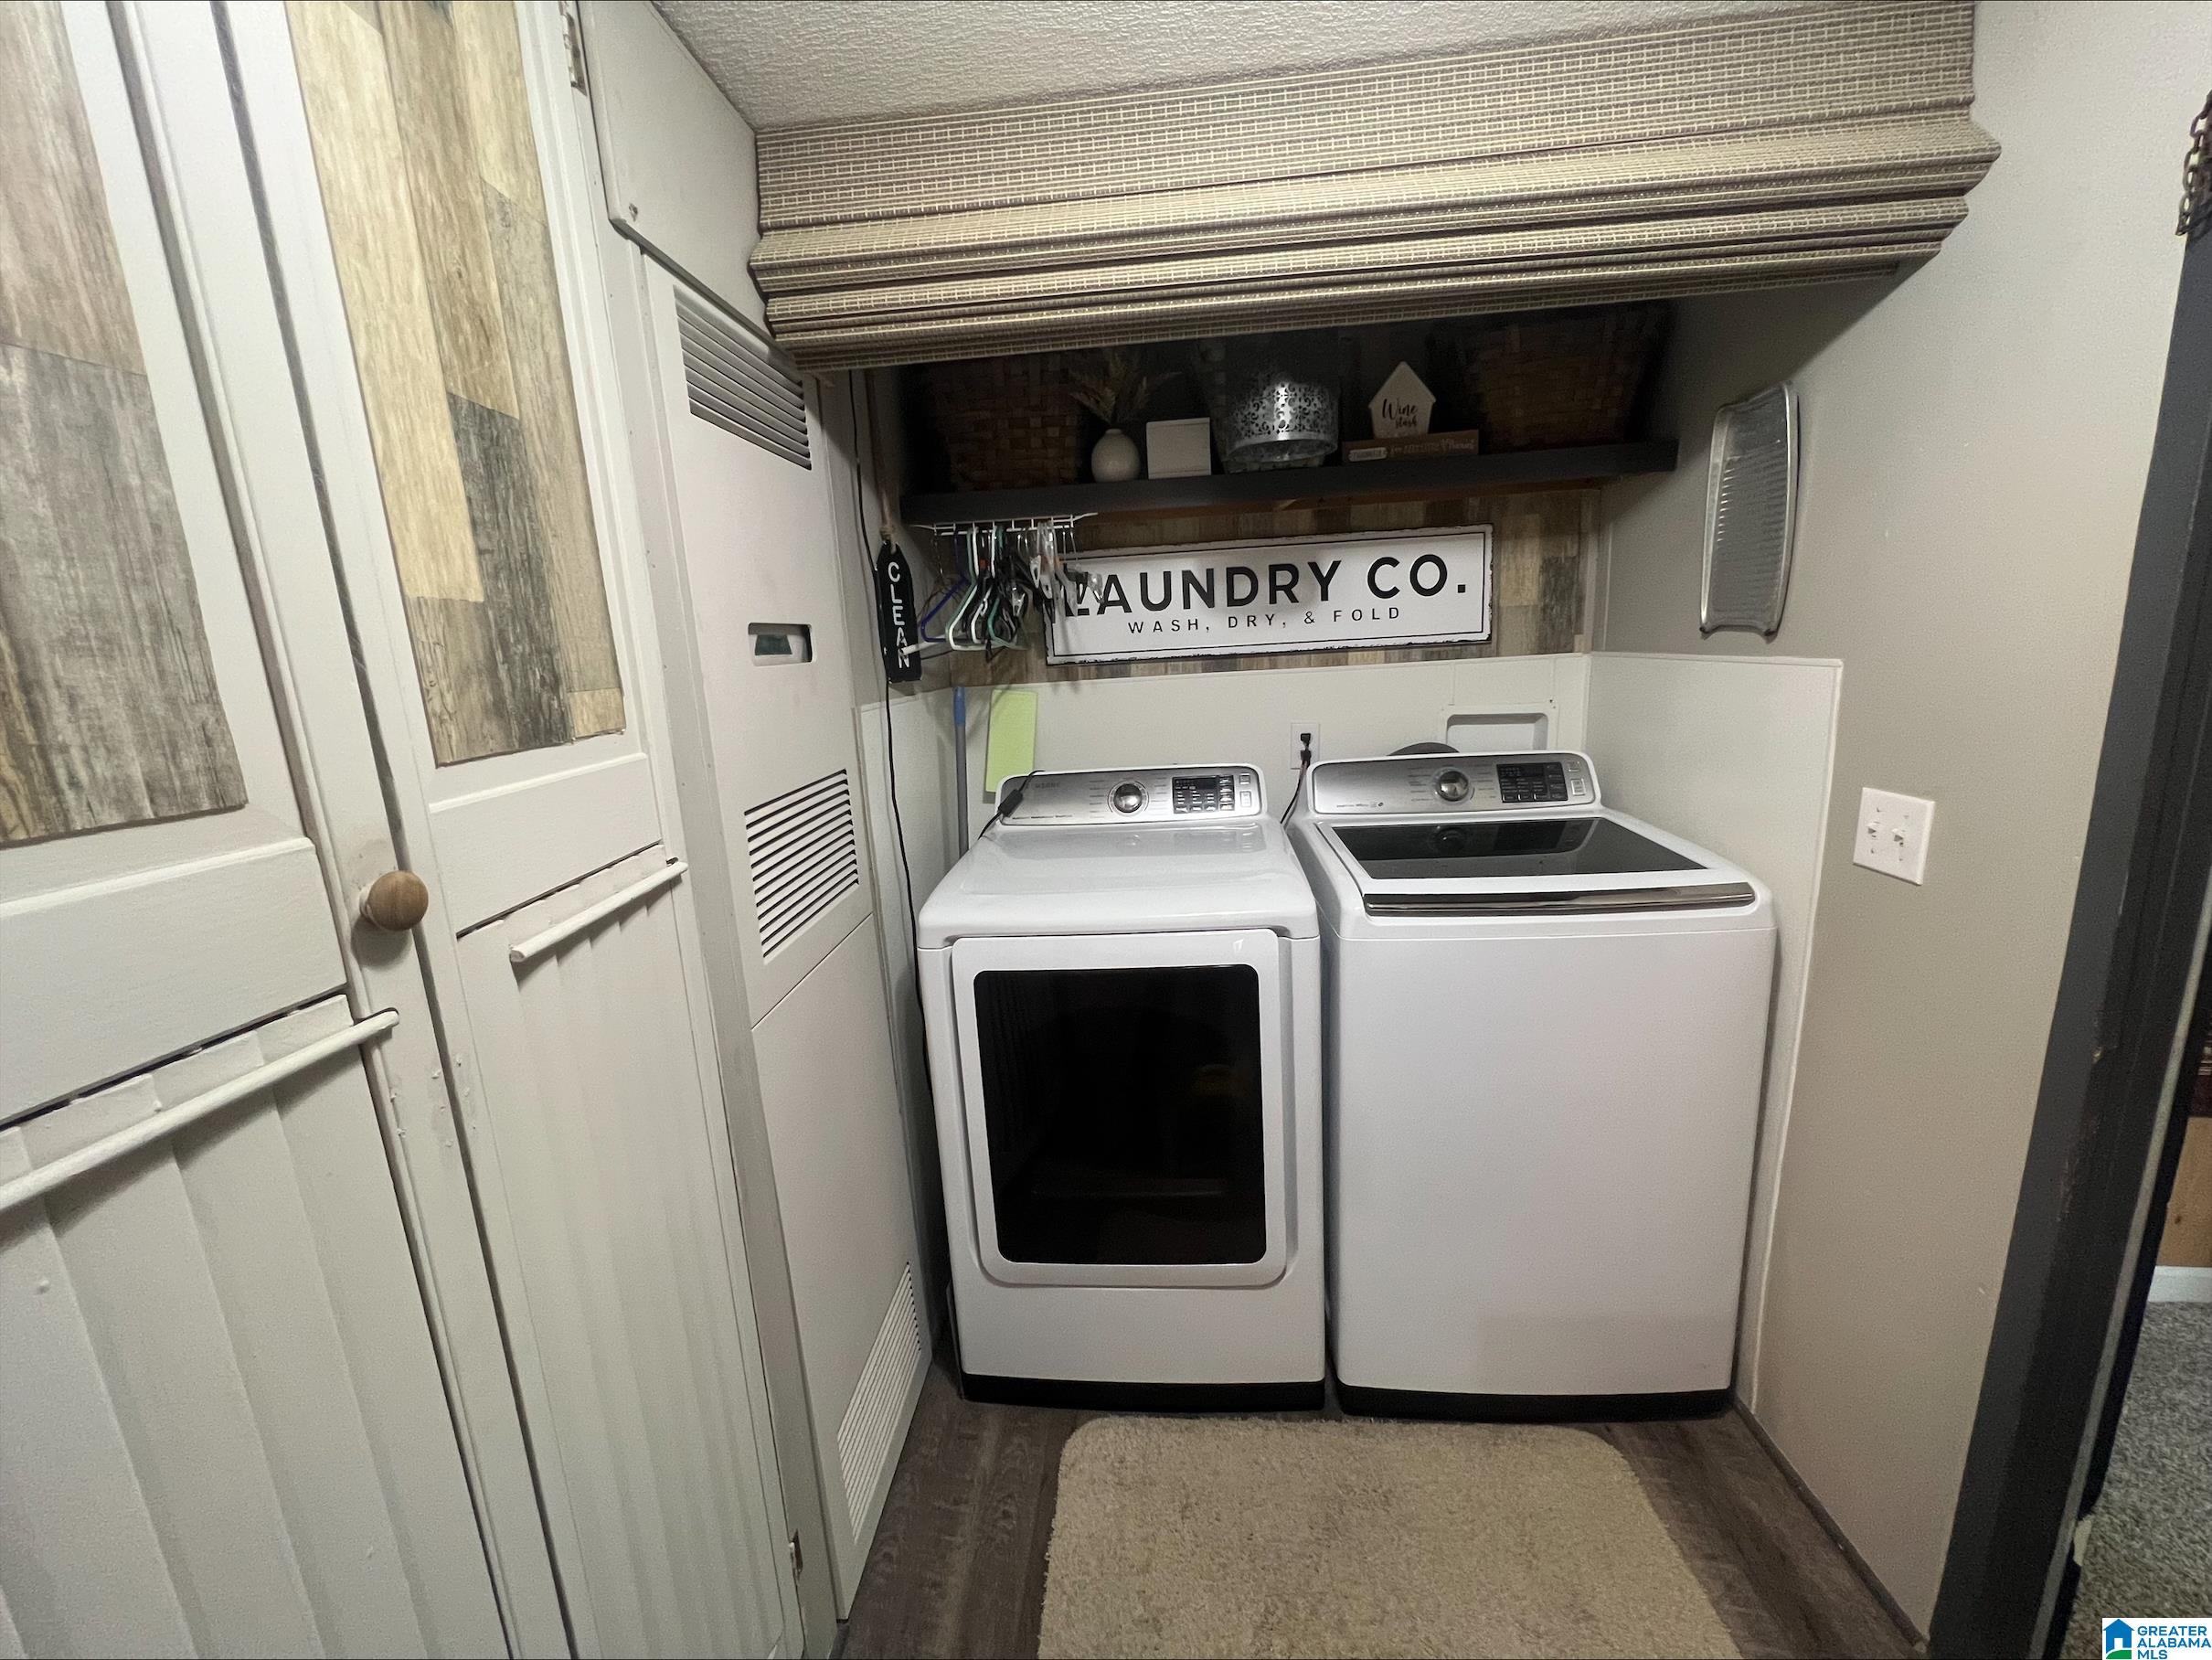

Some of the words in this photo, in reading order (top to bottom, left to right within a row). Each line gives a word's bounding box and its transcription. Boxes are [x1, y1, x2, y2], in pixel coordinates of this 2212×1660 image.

[1382, 399, 1418, 420] Wine
[1367, 554, 1467, 600] CO.
[888, 561, 910, 668] CLEAN
[1129, 618, 1211, 633] WASH,
[1228, 613, 1287, 629] DRY,
[1303, 611, 1316, 623] &
[1334, 607, 1401, 622] FOLD
